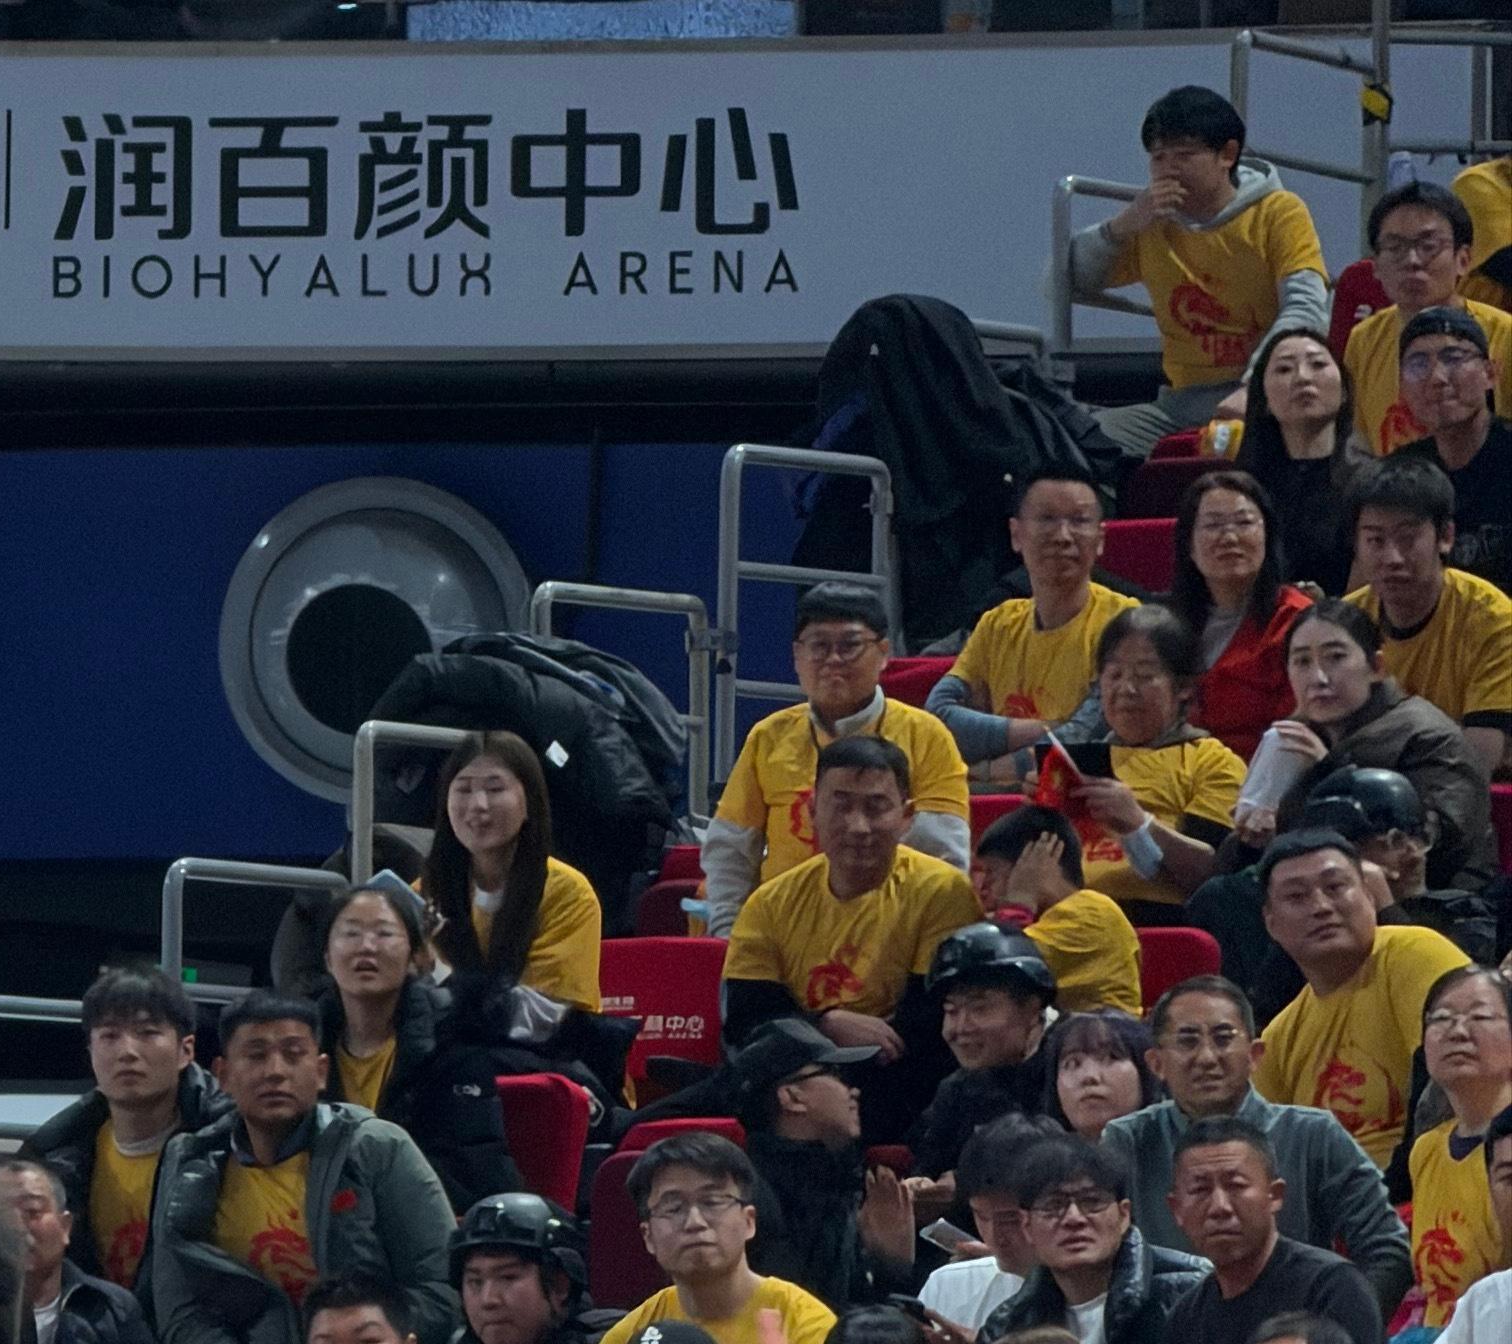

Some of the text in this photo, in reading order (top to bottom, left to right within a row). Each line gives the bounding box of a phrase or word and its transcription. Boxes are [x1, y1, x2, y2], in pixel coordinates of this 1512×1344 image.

[53, 107, 799, 240] 润百颜中心
[52, 248, 799, 299] BIOHYALUX ARENA
